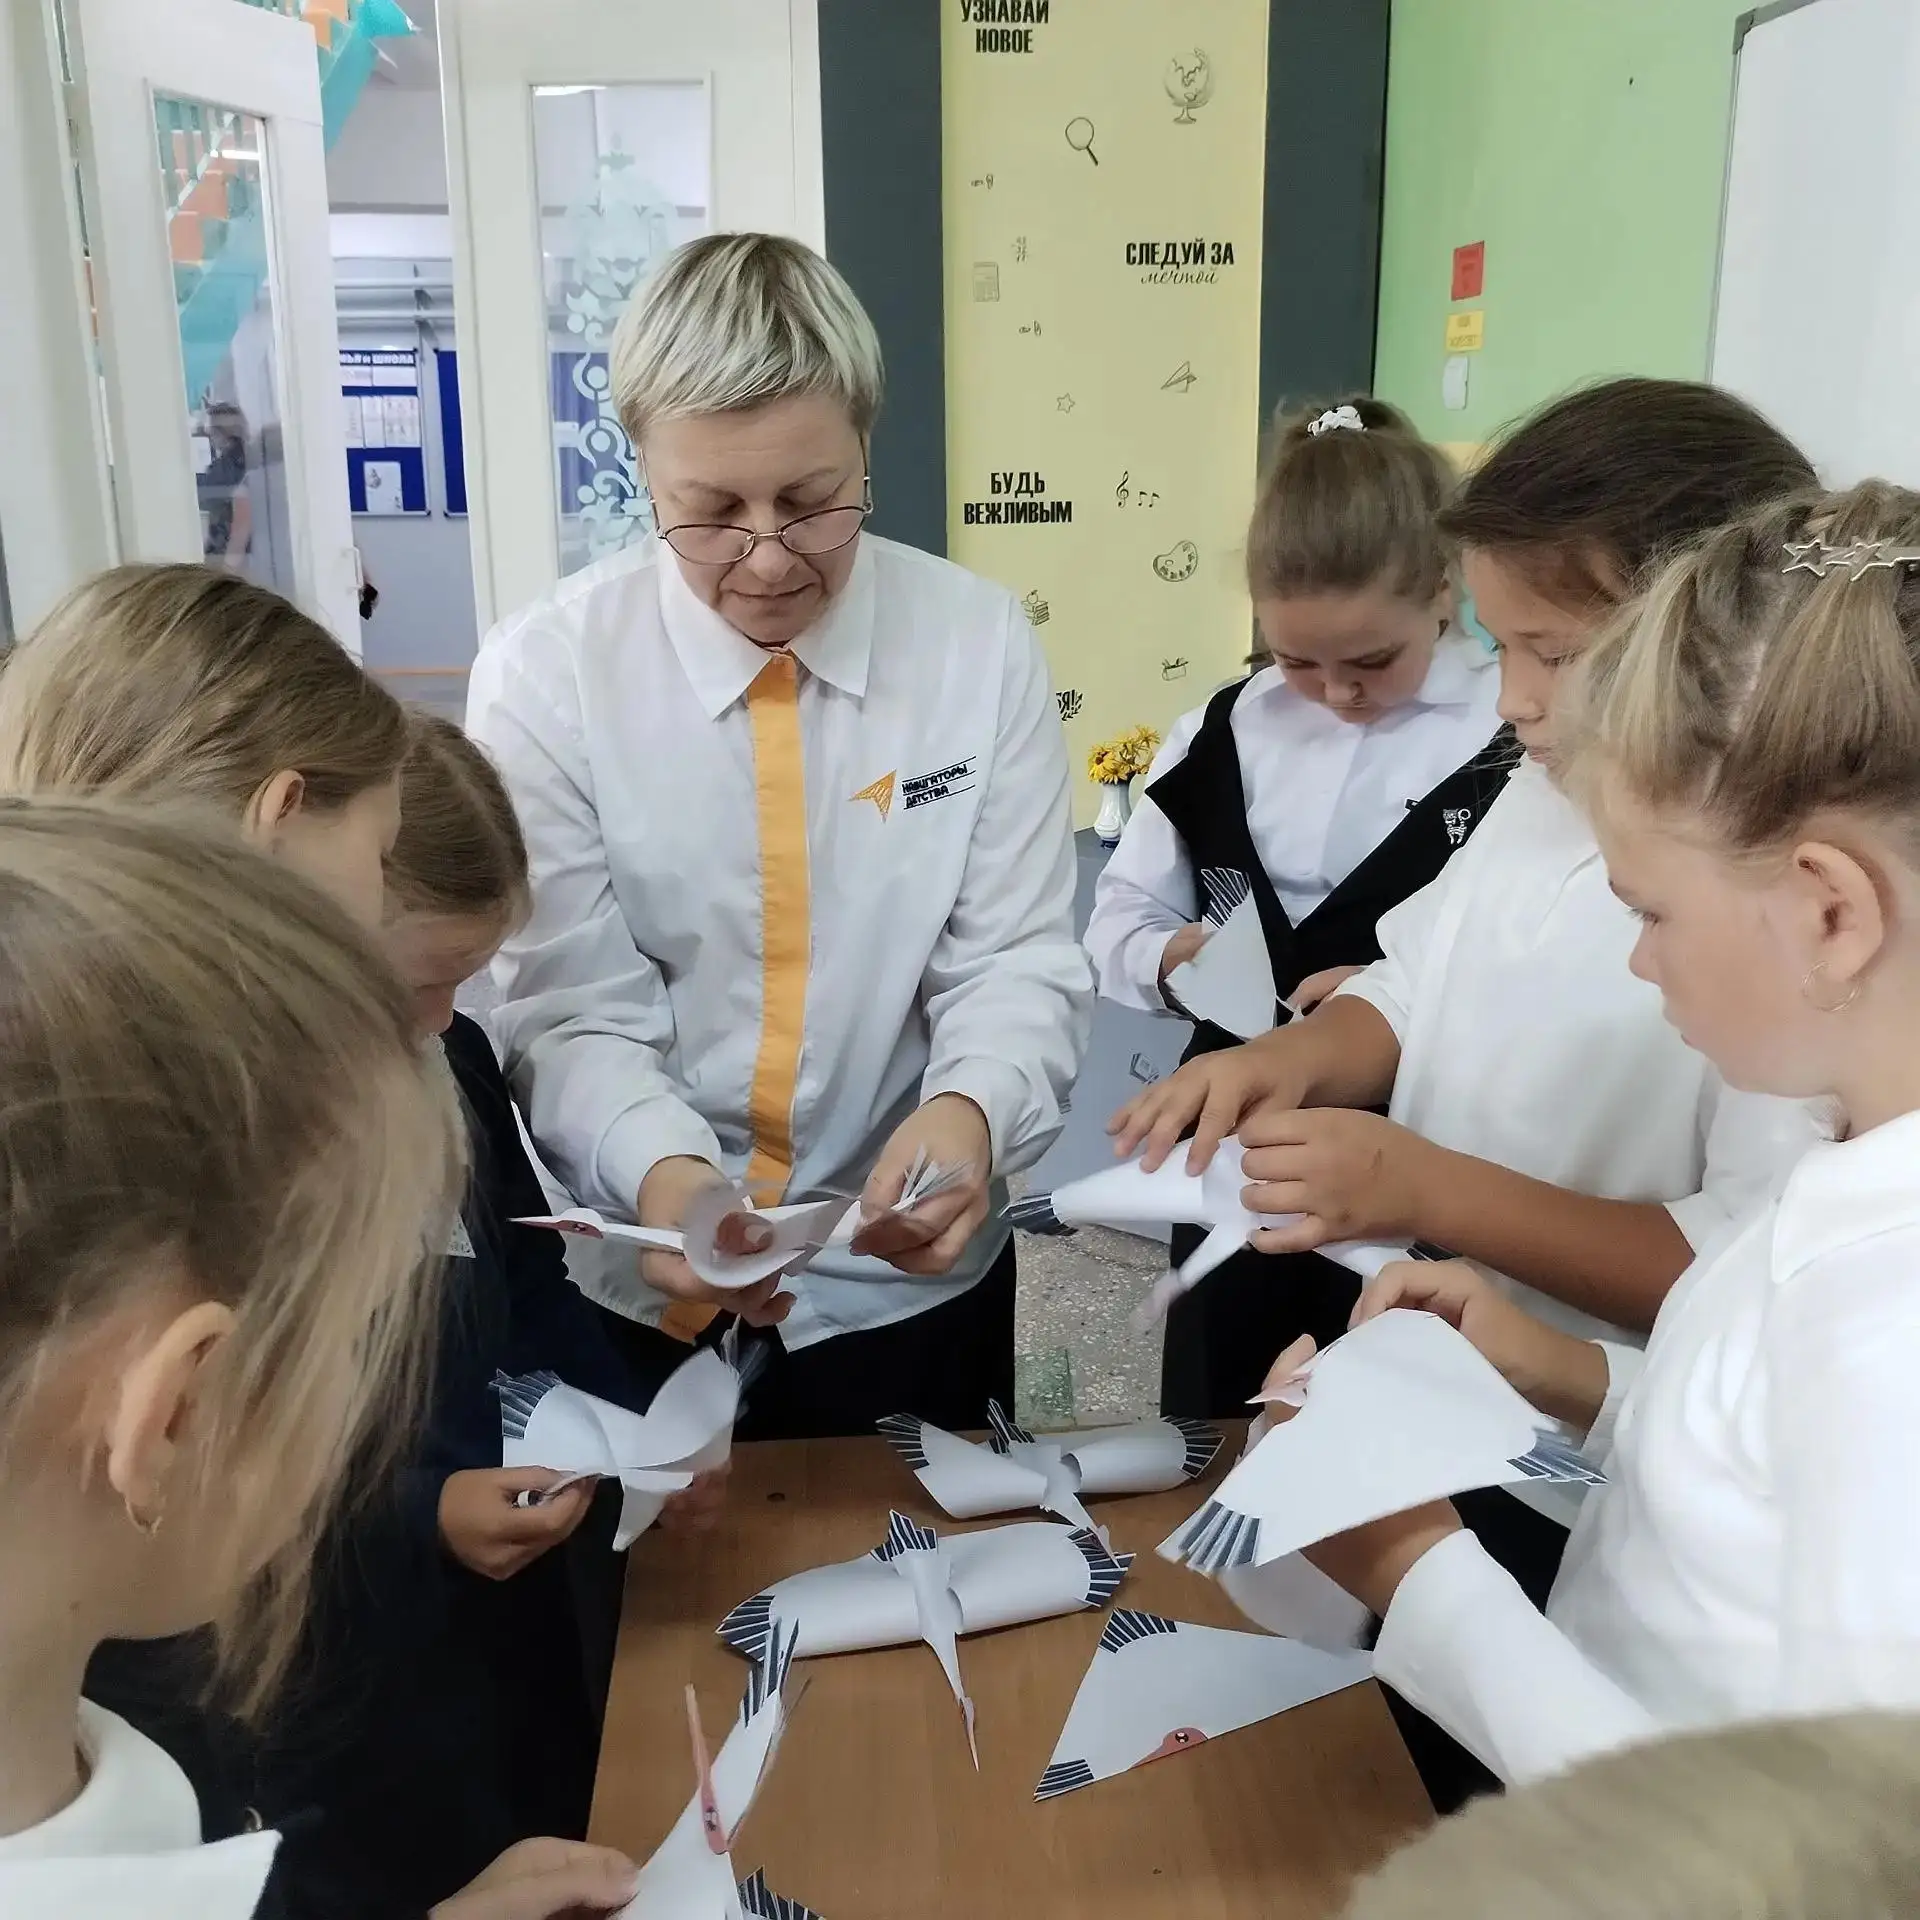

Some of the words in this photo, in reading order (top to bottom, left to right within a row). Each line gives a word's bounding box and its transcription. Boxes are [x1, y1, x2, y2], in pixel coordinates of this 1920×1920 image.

[976, 28, 1033, 53] НОВОЕ
[1126, 237, 1206, 270] СЛЕДУЙ
[1210, 242, 1235, 265] ЗА
[1140, 267, 1220, 284] мечтой
[990, 471, 1046, 498] БУДЬ
[963, 501, 1073, 525] ВЕЖЛИВЫМ
[901, 763, 968, 794] НАВИГАТОРЫ
[905, 785, 950, 809] ДЕТСТВА
